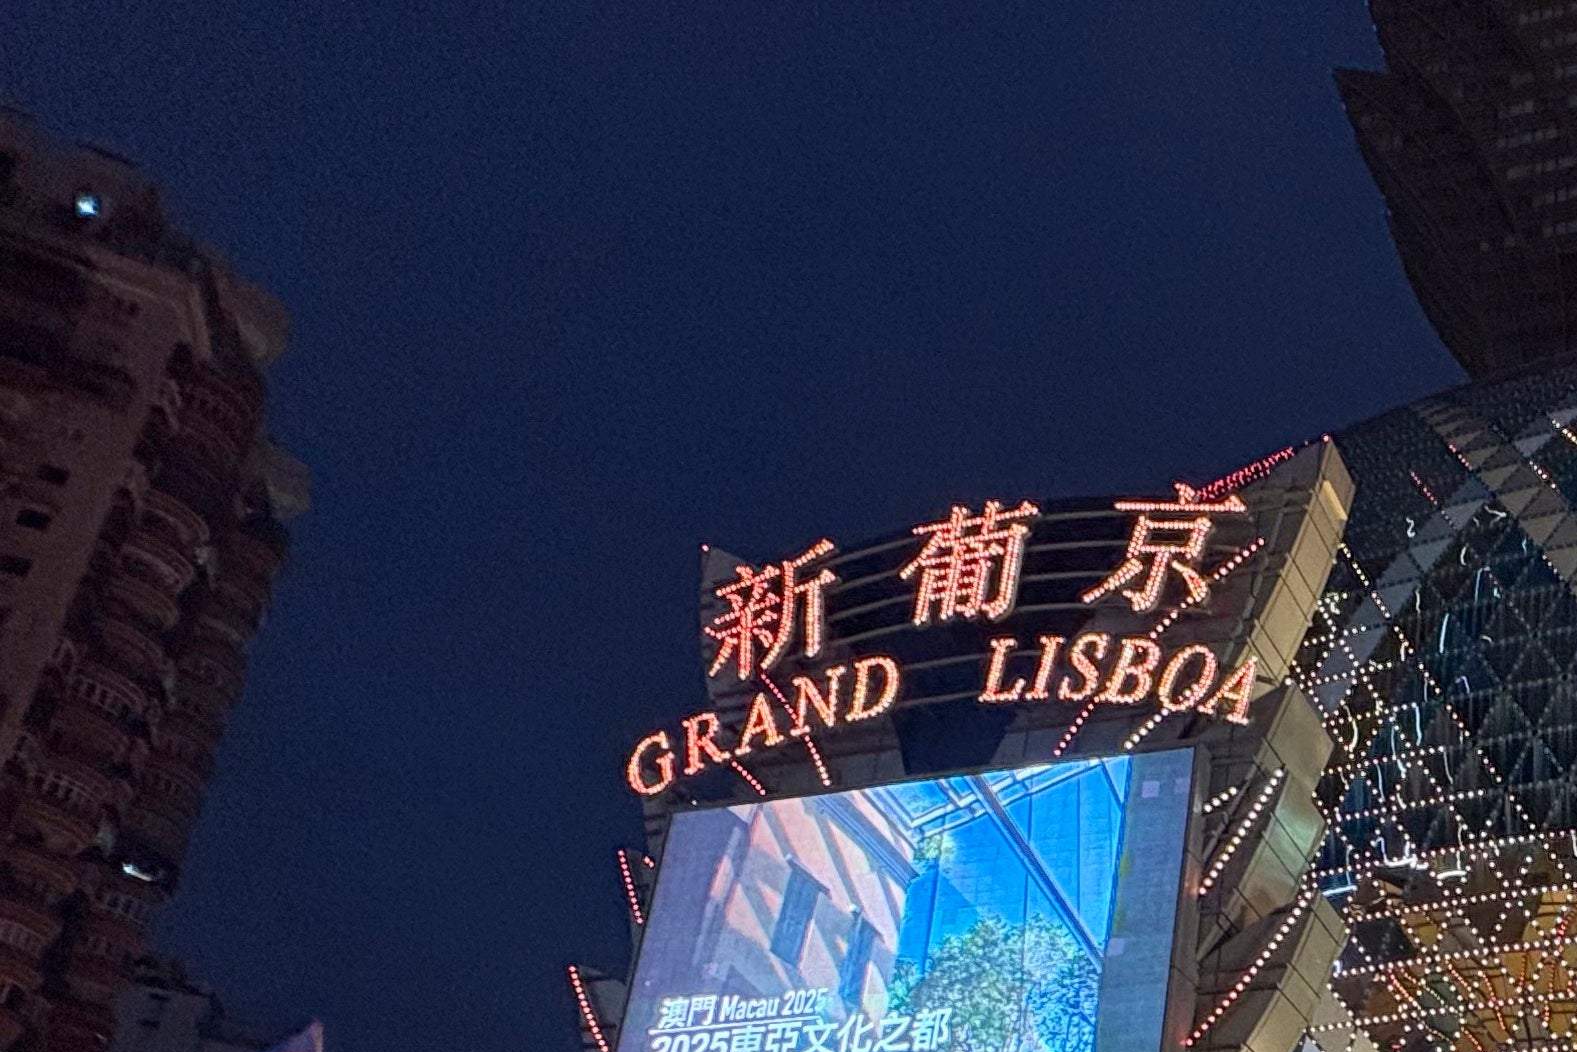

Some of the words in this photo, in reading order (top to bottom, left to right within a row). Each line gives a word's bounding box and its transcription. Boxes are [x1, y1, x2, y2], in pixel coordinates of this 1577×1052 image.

[703, 482, 1248, 681] 新葡京
[625, 654, 902, 797] GRAND
[976, 632, 1260, 727] LISBOA
[657, 994, 718, 1030] 澳門
[719, 994, 779, 1021] Macau
[780, 988, 829, 1017] 2025
